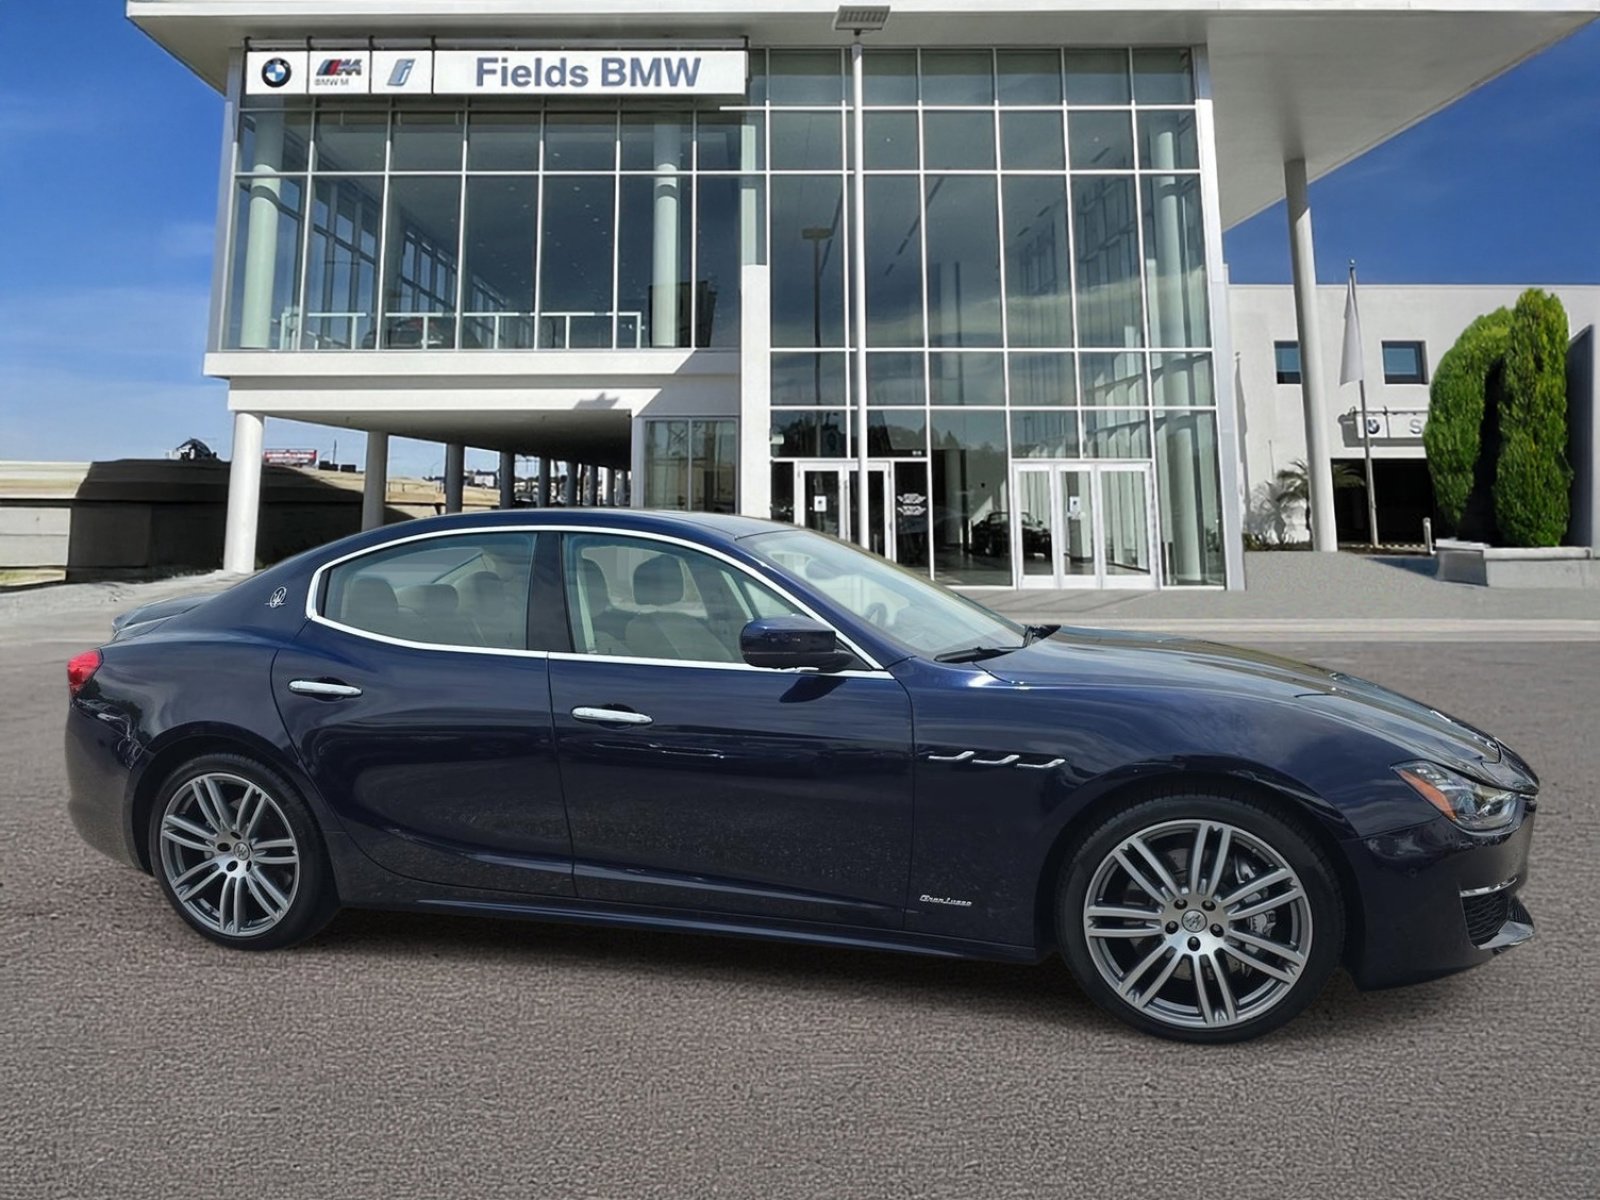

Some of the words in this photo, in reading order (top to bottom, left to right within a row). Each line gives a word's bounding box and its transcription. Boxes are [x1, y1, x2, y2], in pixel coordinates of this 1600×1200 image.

[476, 57, 589, 87] Fields
[601, 57, 701, 87] BMW
[314, 78, 338, 86] BMW
